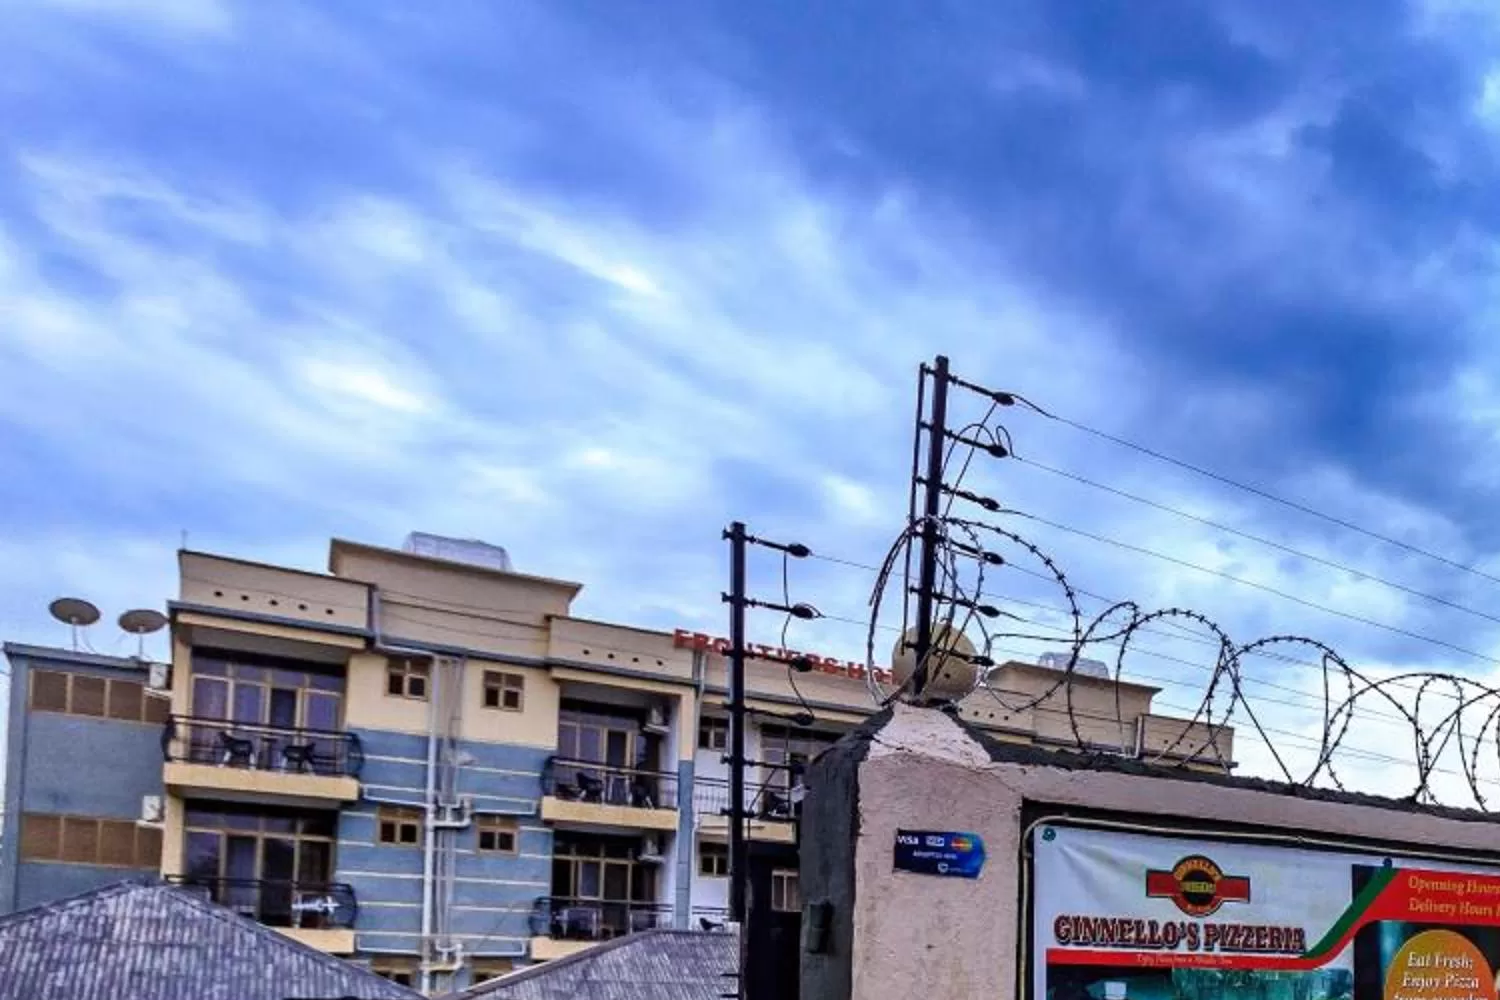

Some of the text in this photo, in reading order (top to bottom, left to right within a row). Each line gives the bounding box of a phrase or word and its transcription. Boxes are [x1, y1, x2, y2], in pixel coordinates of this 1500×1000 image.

[1408, 897, 1456, 916] Delivery
[1460, 902, 1492, 917] Hours
[1054, 914, 1306, 953] GINNELLO'S PIZZERIA
[1408, 951, 1431, 967] Eat
[1402, 971, 1480, 992] Enjoy Pizza
